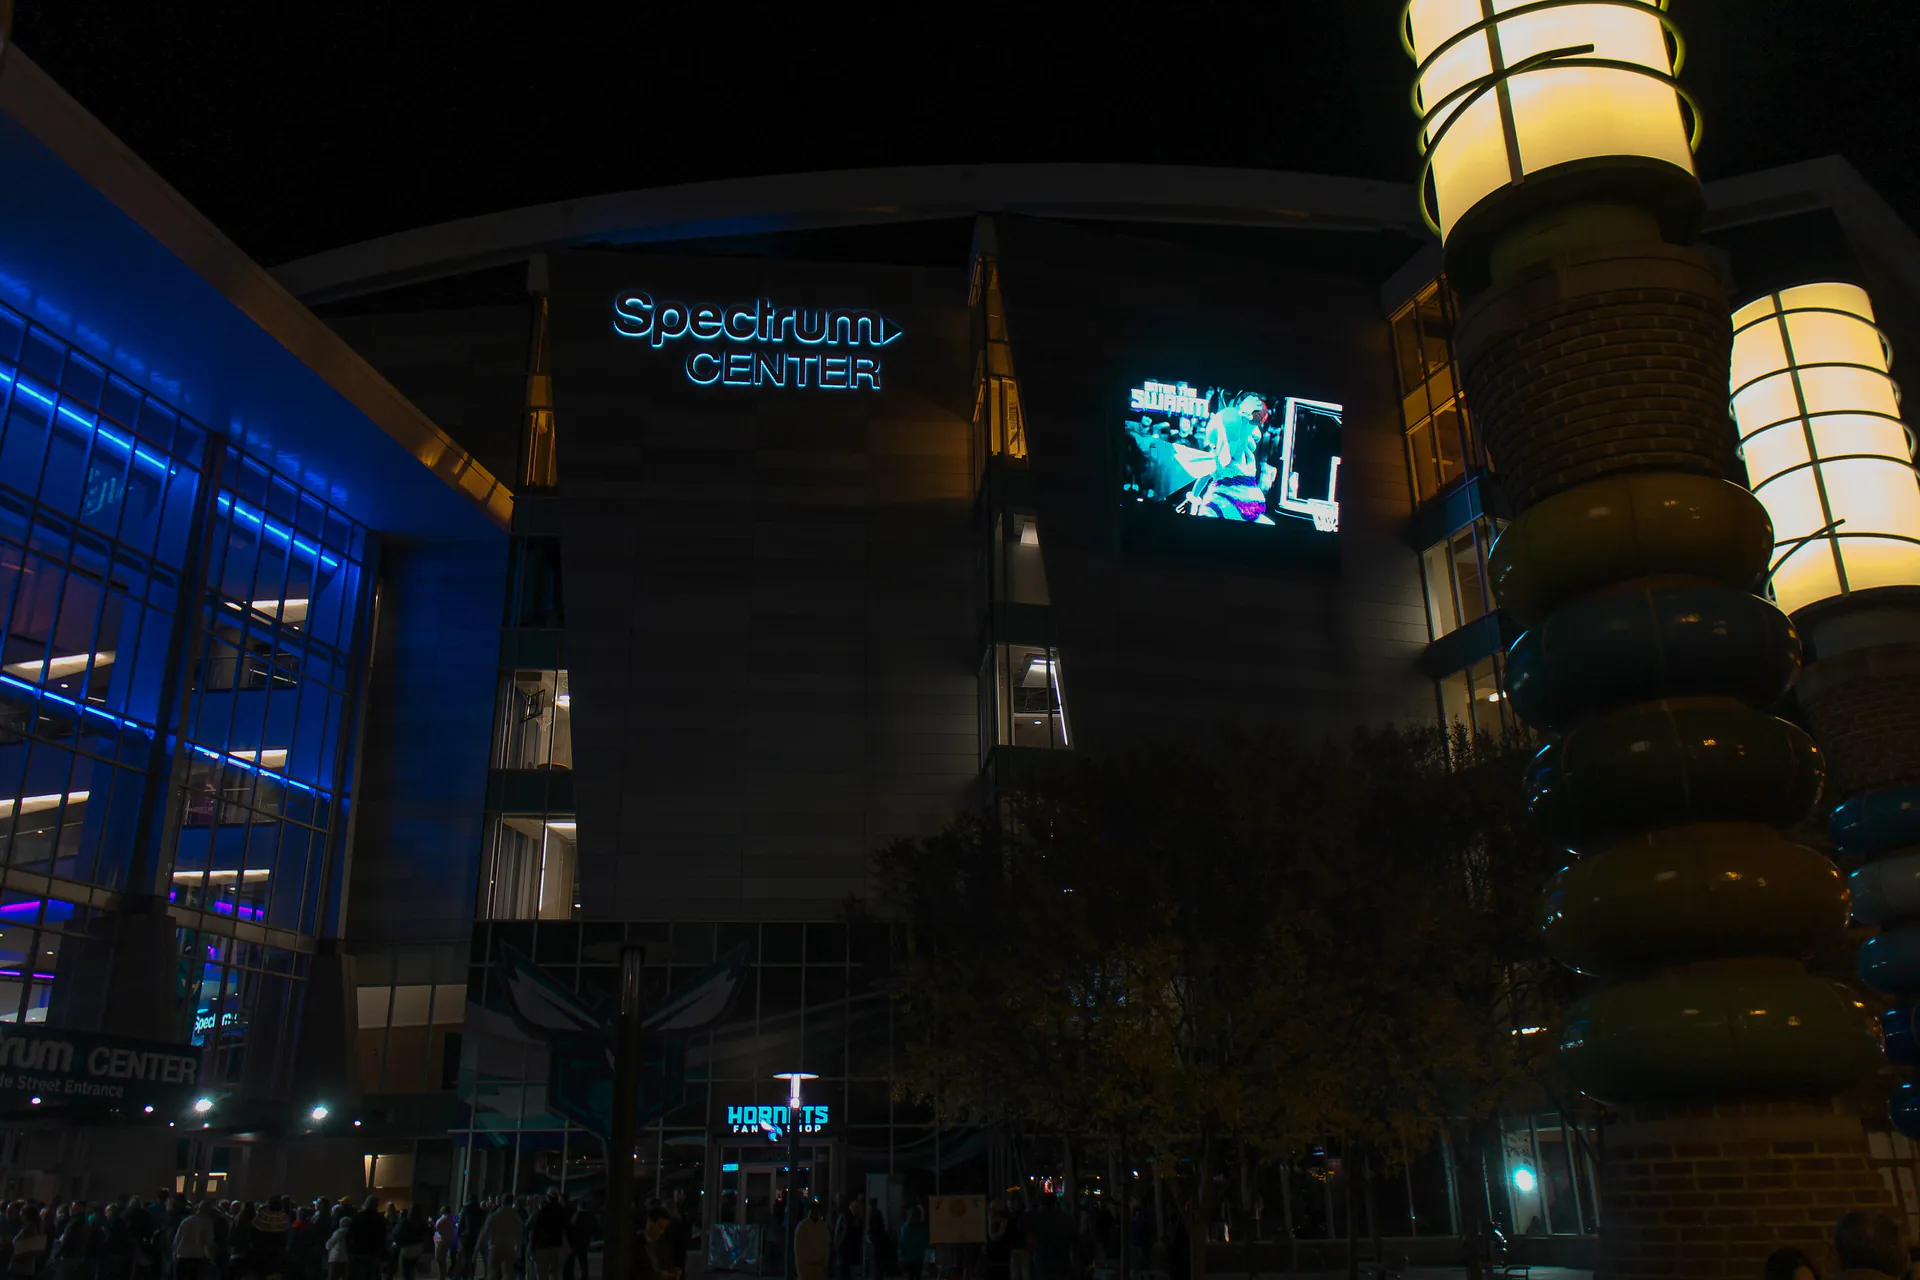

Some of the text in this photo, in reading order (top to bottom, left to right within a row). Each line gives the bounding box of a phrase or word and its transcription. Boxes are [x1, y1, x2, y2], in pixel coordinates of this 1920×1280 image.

[613, 291, 883, 348] Spectrum
[686, 351, 881, 390] CENTER
[1131, 388, 1209, 418] SWARM
[0, 1033, 197, 1085] rum CENTER
[16, 1074, 61, 1092] Street
[64, 1079, 124, 1098] Entrance
[727, 1106, 829, 1124] HORNTS
[733, 1124, 759, 1133] FAN
